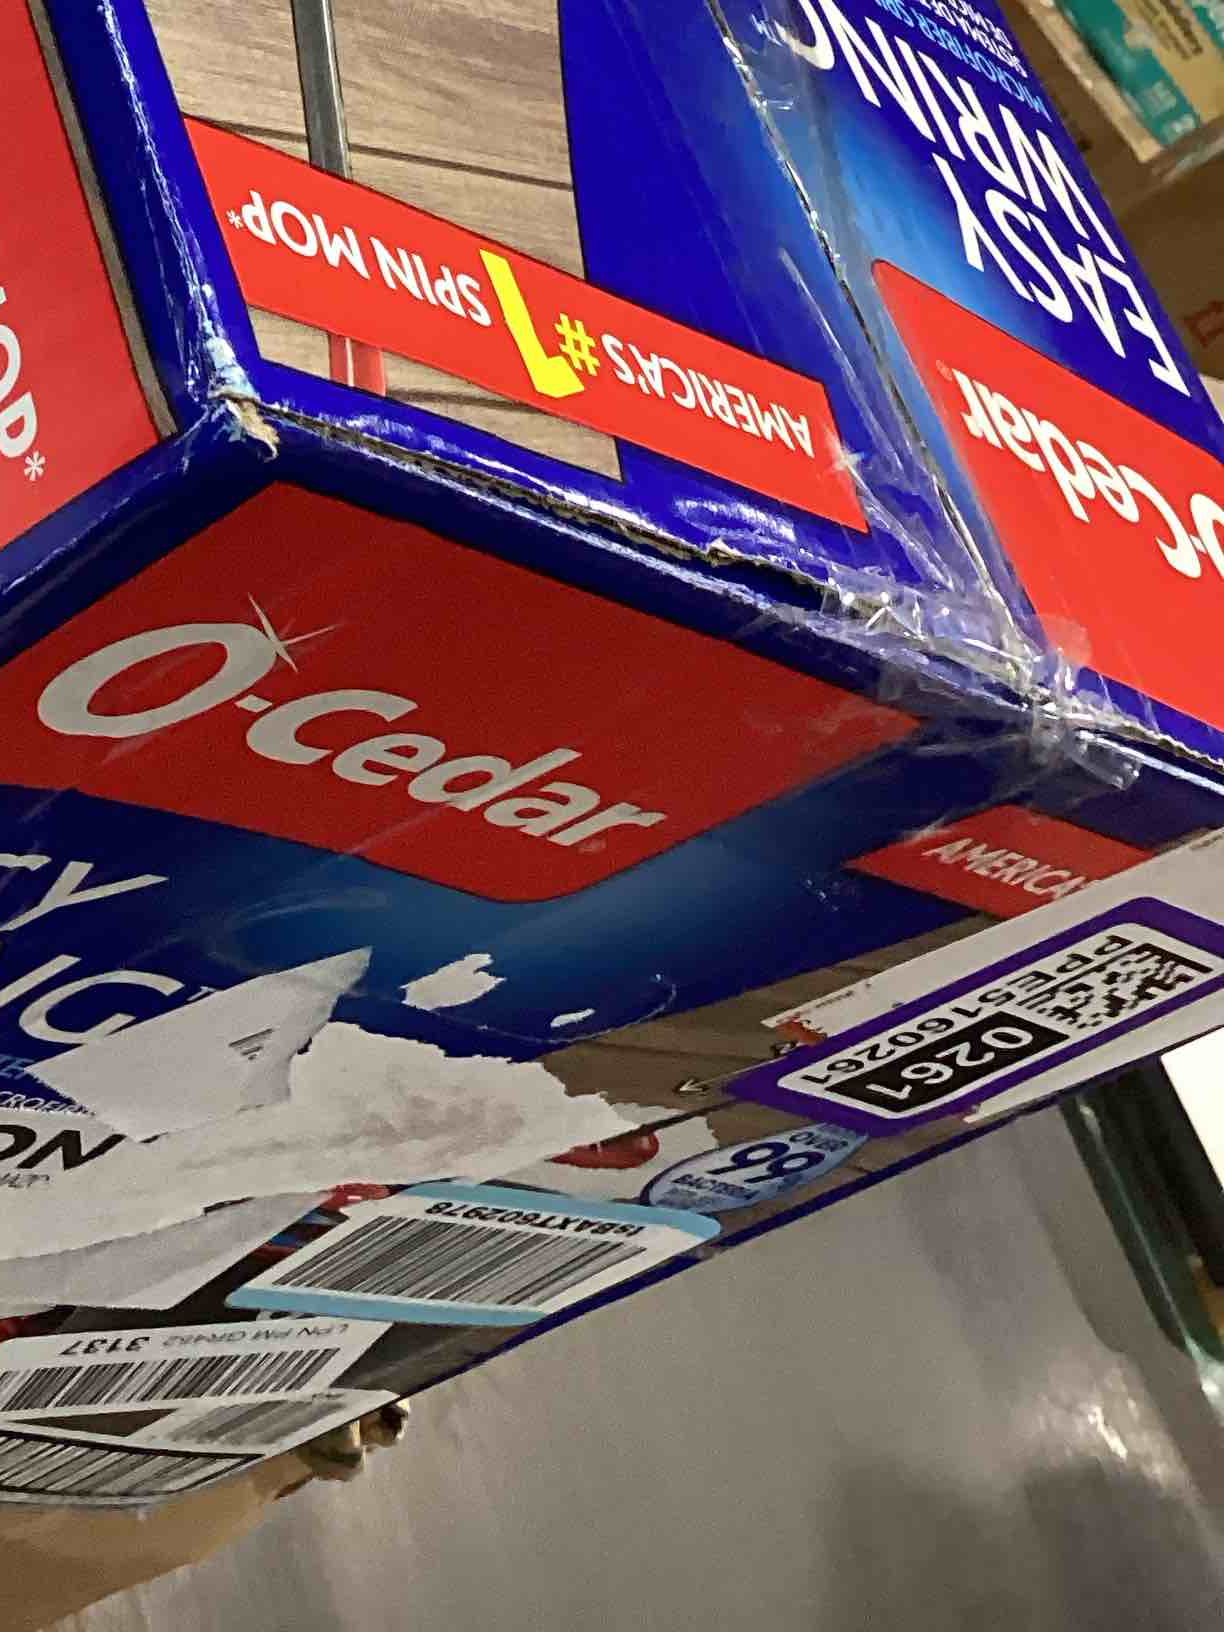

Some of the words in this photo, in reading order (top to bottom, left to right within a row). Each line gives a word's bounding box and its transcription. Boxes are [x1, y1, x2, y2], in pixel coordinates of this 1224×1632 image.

[909, 7, 1053, 123] MICROFIBER
[370, 236, 492, 329] SPIN
[932, 152, 1191, 397] EASY
[602, 334, 815, 458] AMERICA'S
[801, 934, 1134, 1086] PPE5160261
[865, 1025, 1034, 1102] 0261
[58, 1335, 151, 1357] 3137
